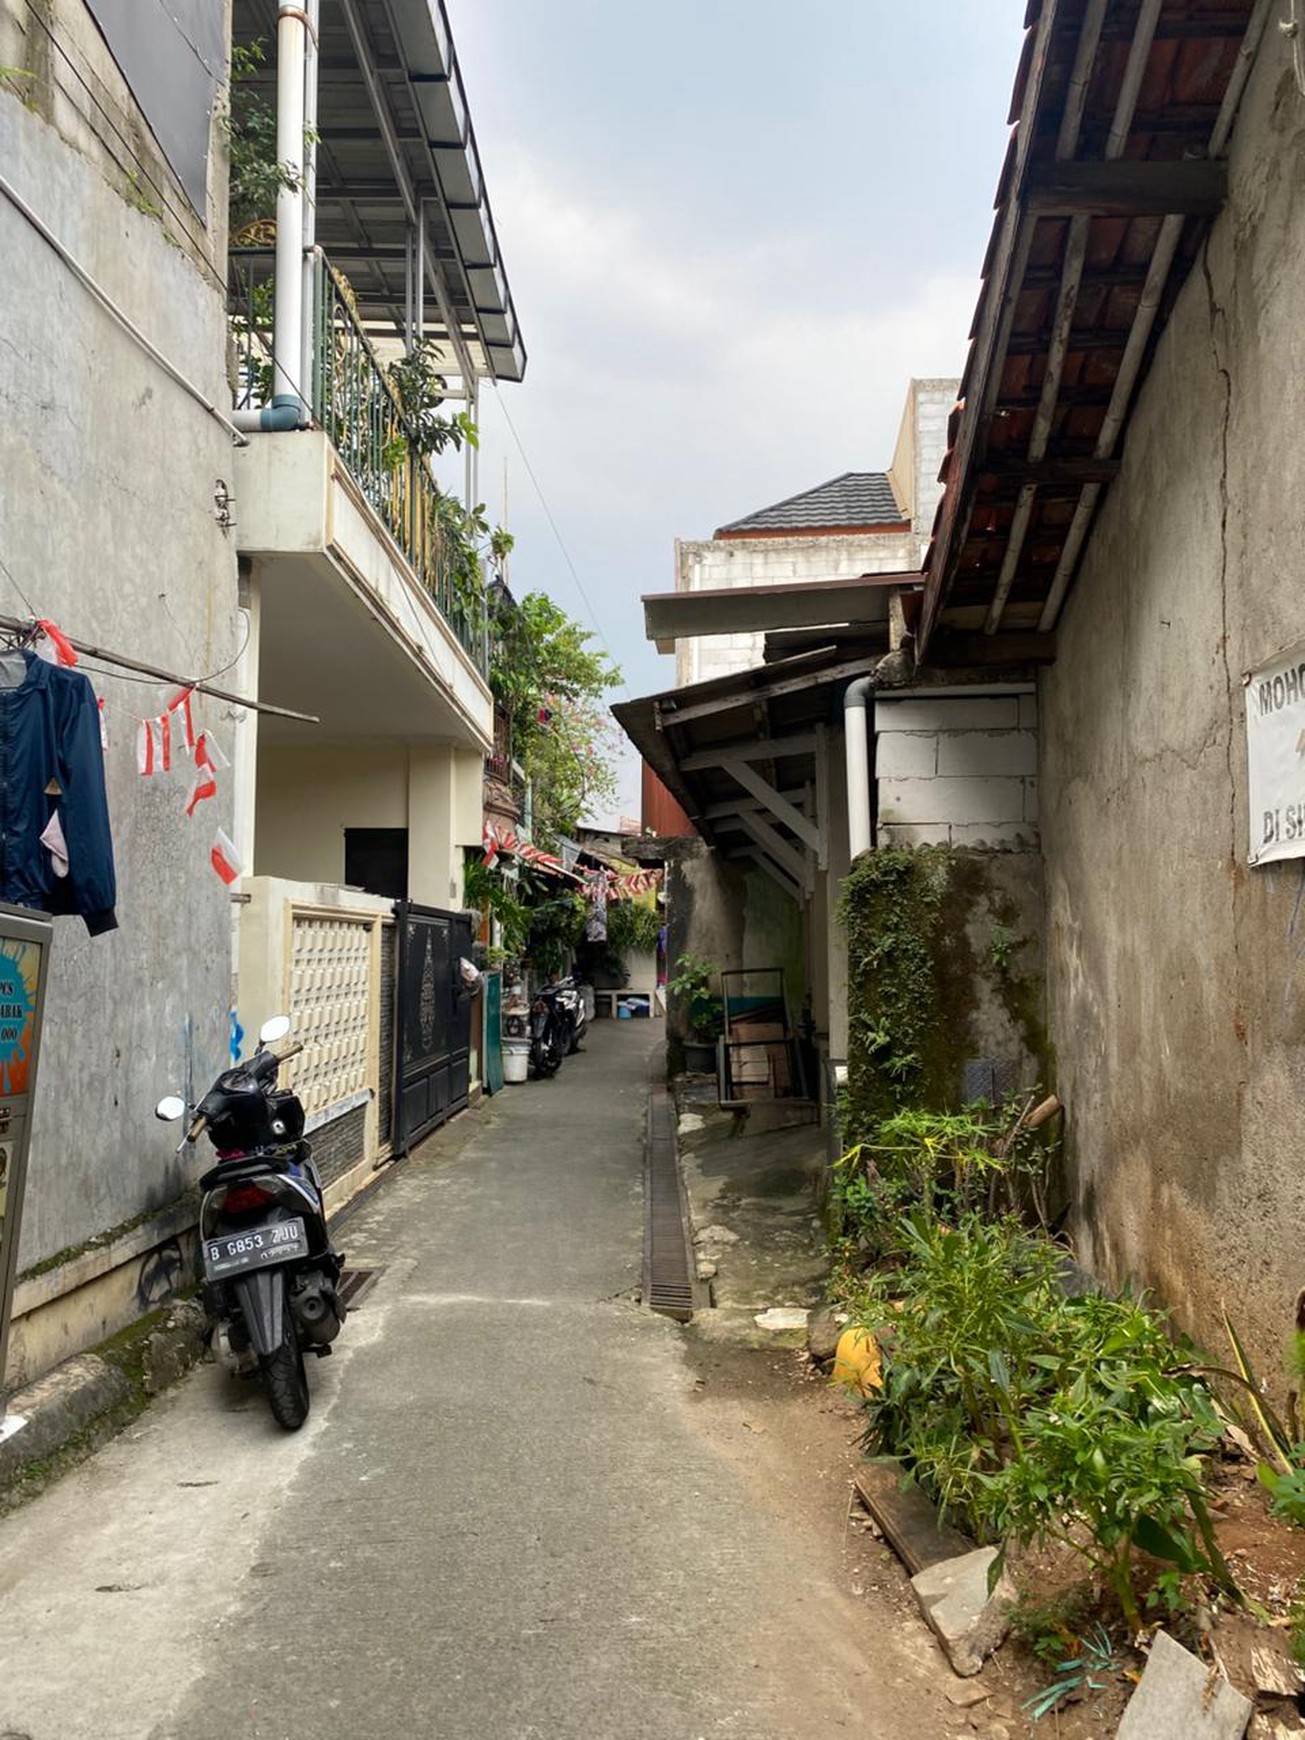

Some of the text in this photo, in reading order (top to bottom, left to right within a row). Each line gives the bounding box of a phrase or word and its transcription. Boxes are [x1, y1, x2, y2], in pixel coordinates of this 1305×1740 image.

[1263, 803, 1305, 844] DI SI
[210, 1246, 220, 1261] B
[227, 1234, 264, 1256] 6853
